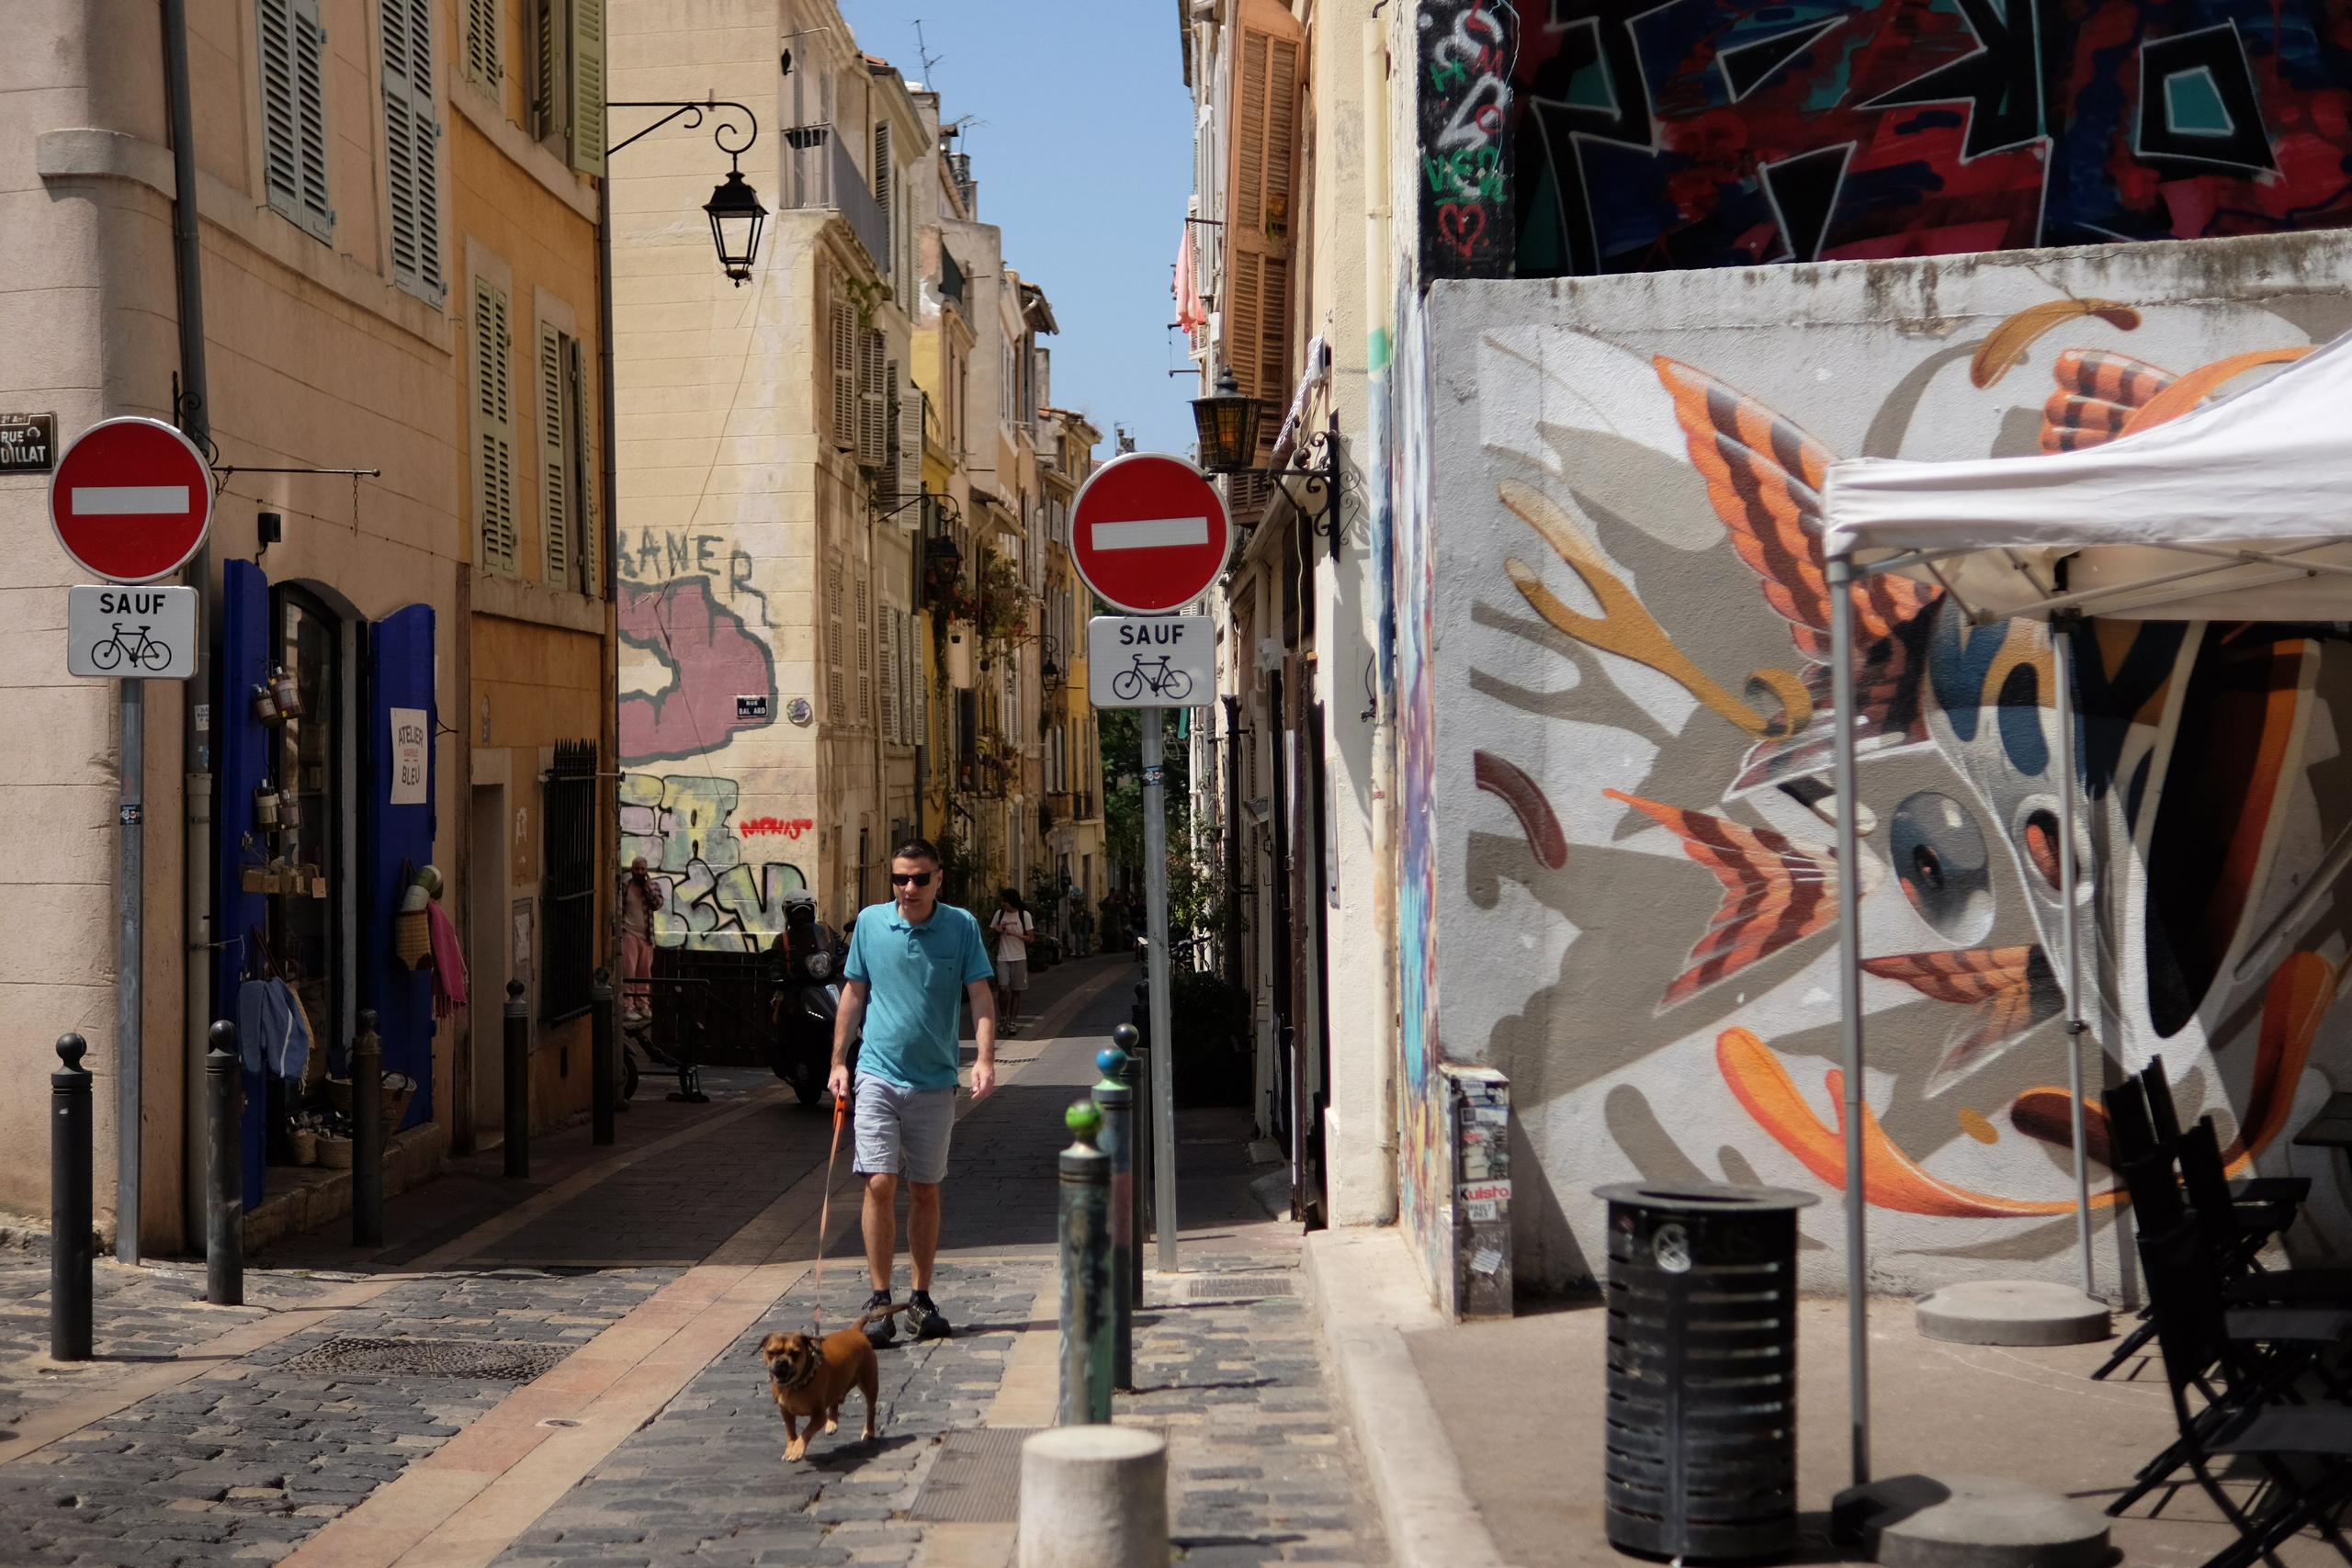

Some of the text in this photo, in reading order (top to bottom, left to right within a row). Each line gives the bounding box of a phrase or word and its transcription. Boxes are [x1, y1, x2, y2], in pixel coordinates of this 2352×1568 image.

[1, 431, 24, 443] RUE
[99, 592, 166, 615] SAUF
[1119, 624, 1185, 645] SAUF
[398, 725, 424, 747] ATELIER
[401, 764, 421, 786] BLEU
